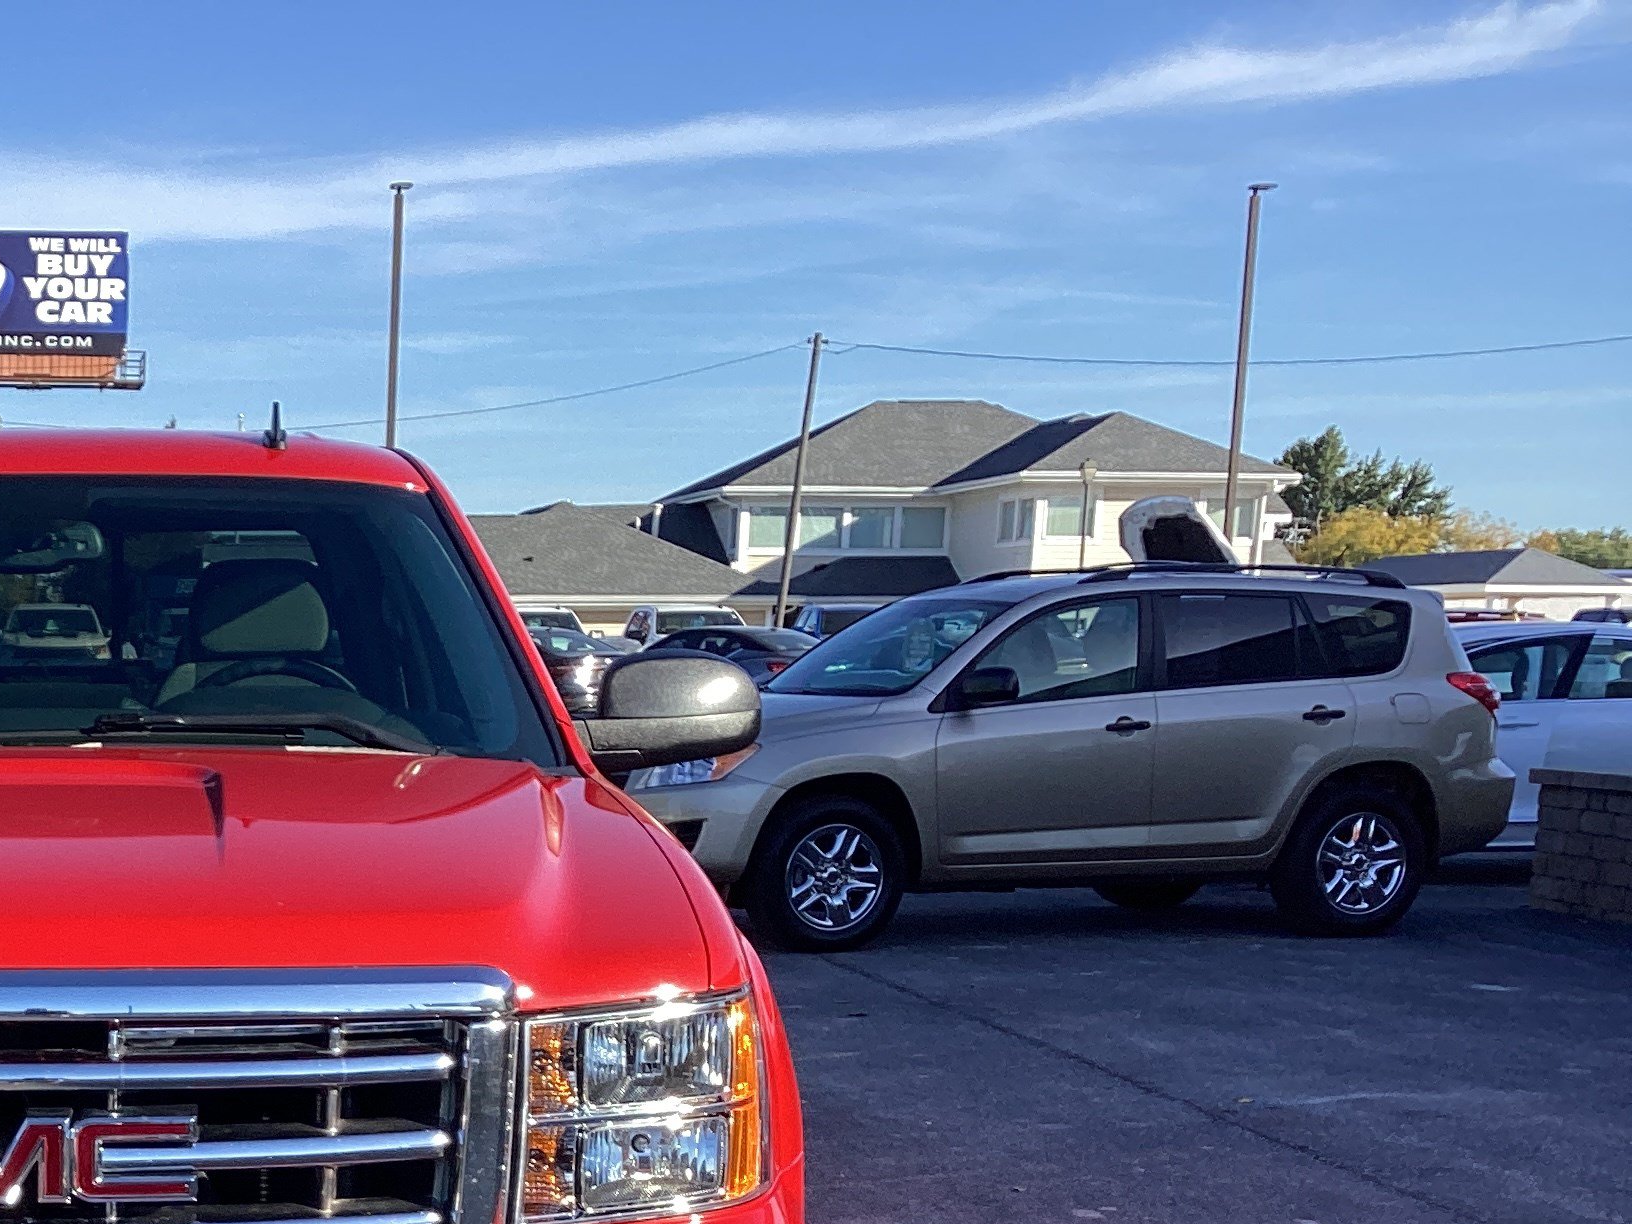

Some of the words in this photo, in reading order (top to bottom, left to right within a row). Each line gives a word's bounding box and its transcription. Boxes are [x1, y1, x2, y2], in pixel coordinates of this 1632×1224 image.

[29, 237, 65, 252] WE
[68, 238, 121, 254] WILL
[36, 254, 115, 276] BUY
[21, 277, 127, 300] YOUR
[35, 300, 113, 324] CAR
